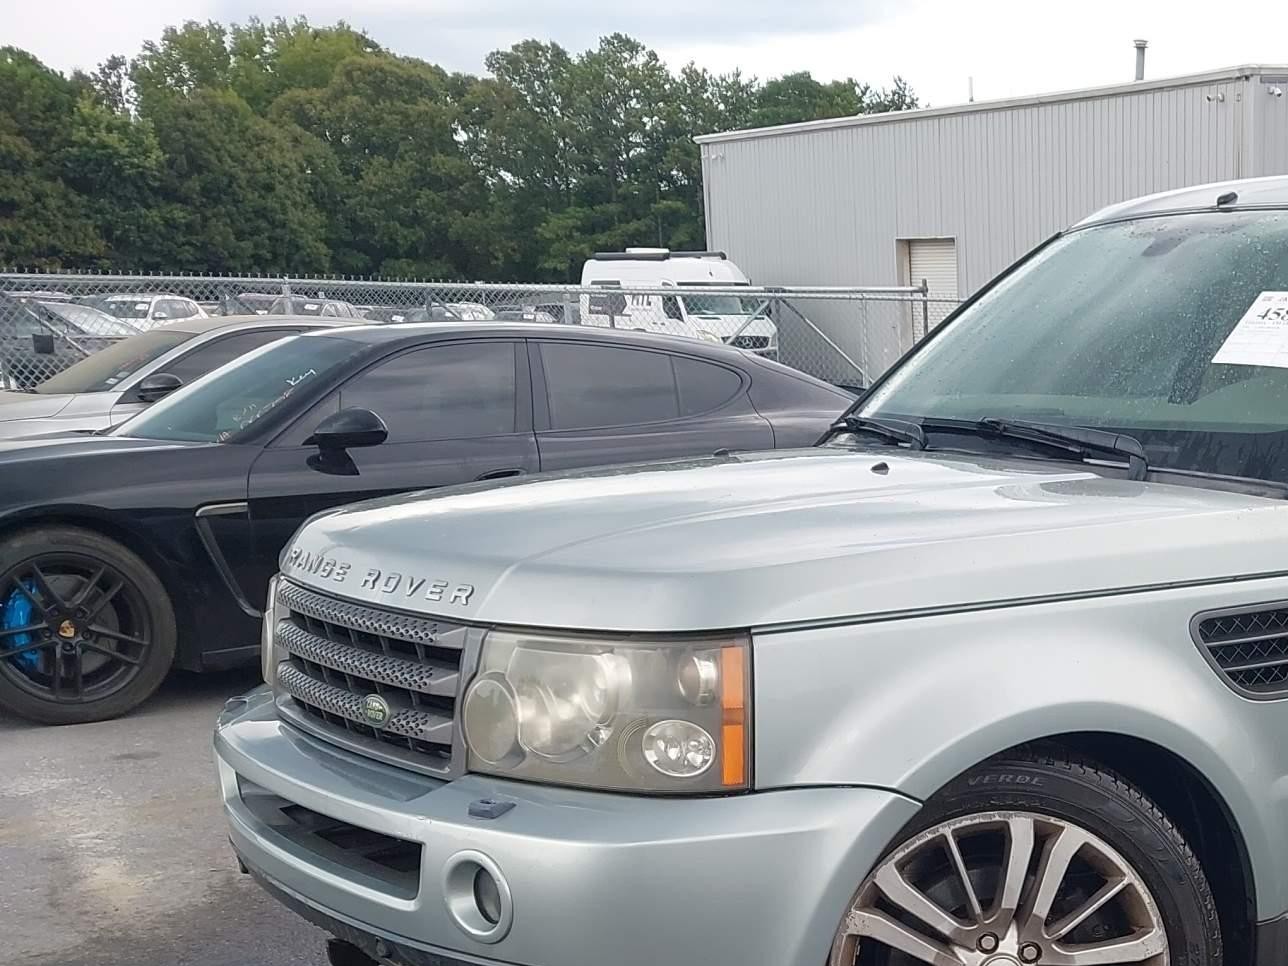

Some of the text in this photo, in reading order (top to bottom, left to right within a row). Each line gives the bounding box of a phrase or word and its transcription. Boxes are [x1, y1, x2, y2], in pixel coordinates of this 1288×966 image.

[288, 548, 475, 606] RANGE ROVER
[968, 774, 1045, 786] VERDE
